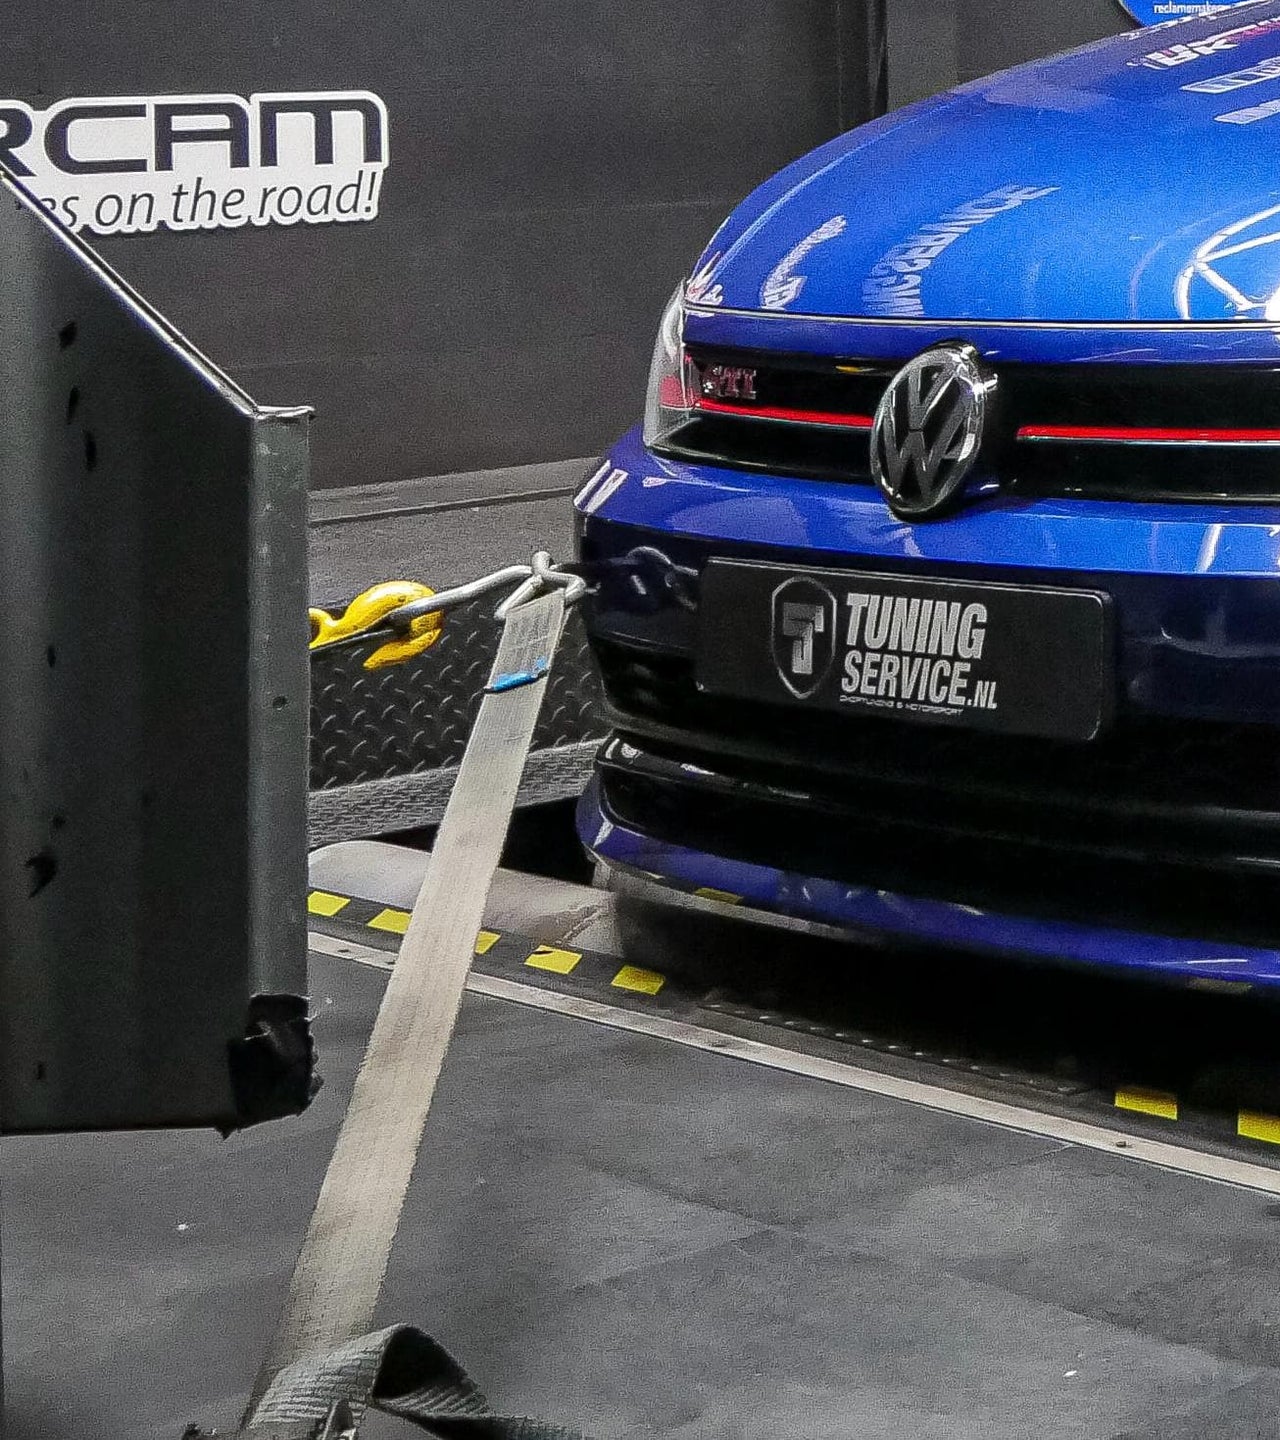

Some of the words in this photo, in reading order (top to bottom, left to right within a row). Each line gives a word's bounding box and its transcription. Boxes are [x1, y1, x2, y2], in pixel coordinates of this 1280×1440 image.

[95, 193, 154, 227] on
[173, 176, 244, 223] the
[260, 169, 376, 219] road!
[846, 592, 988, 660] TUNING
[841, 649, 998, 709] SERVICE.NL
